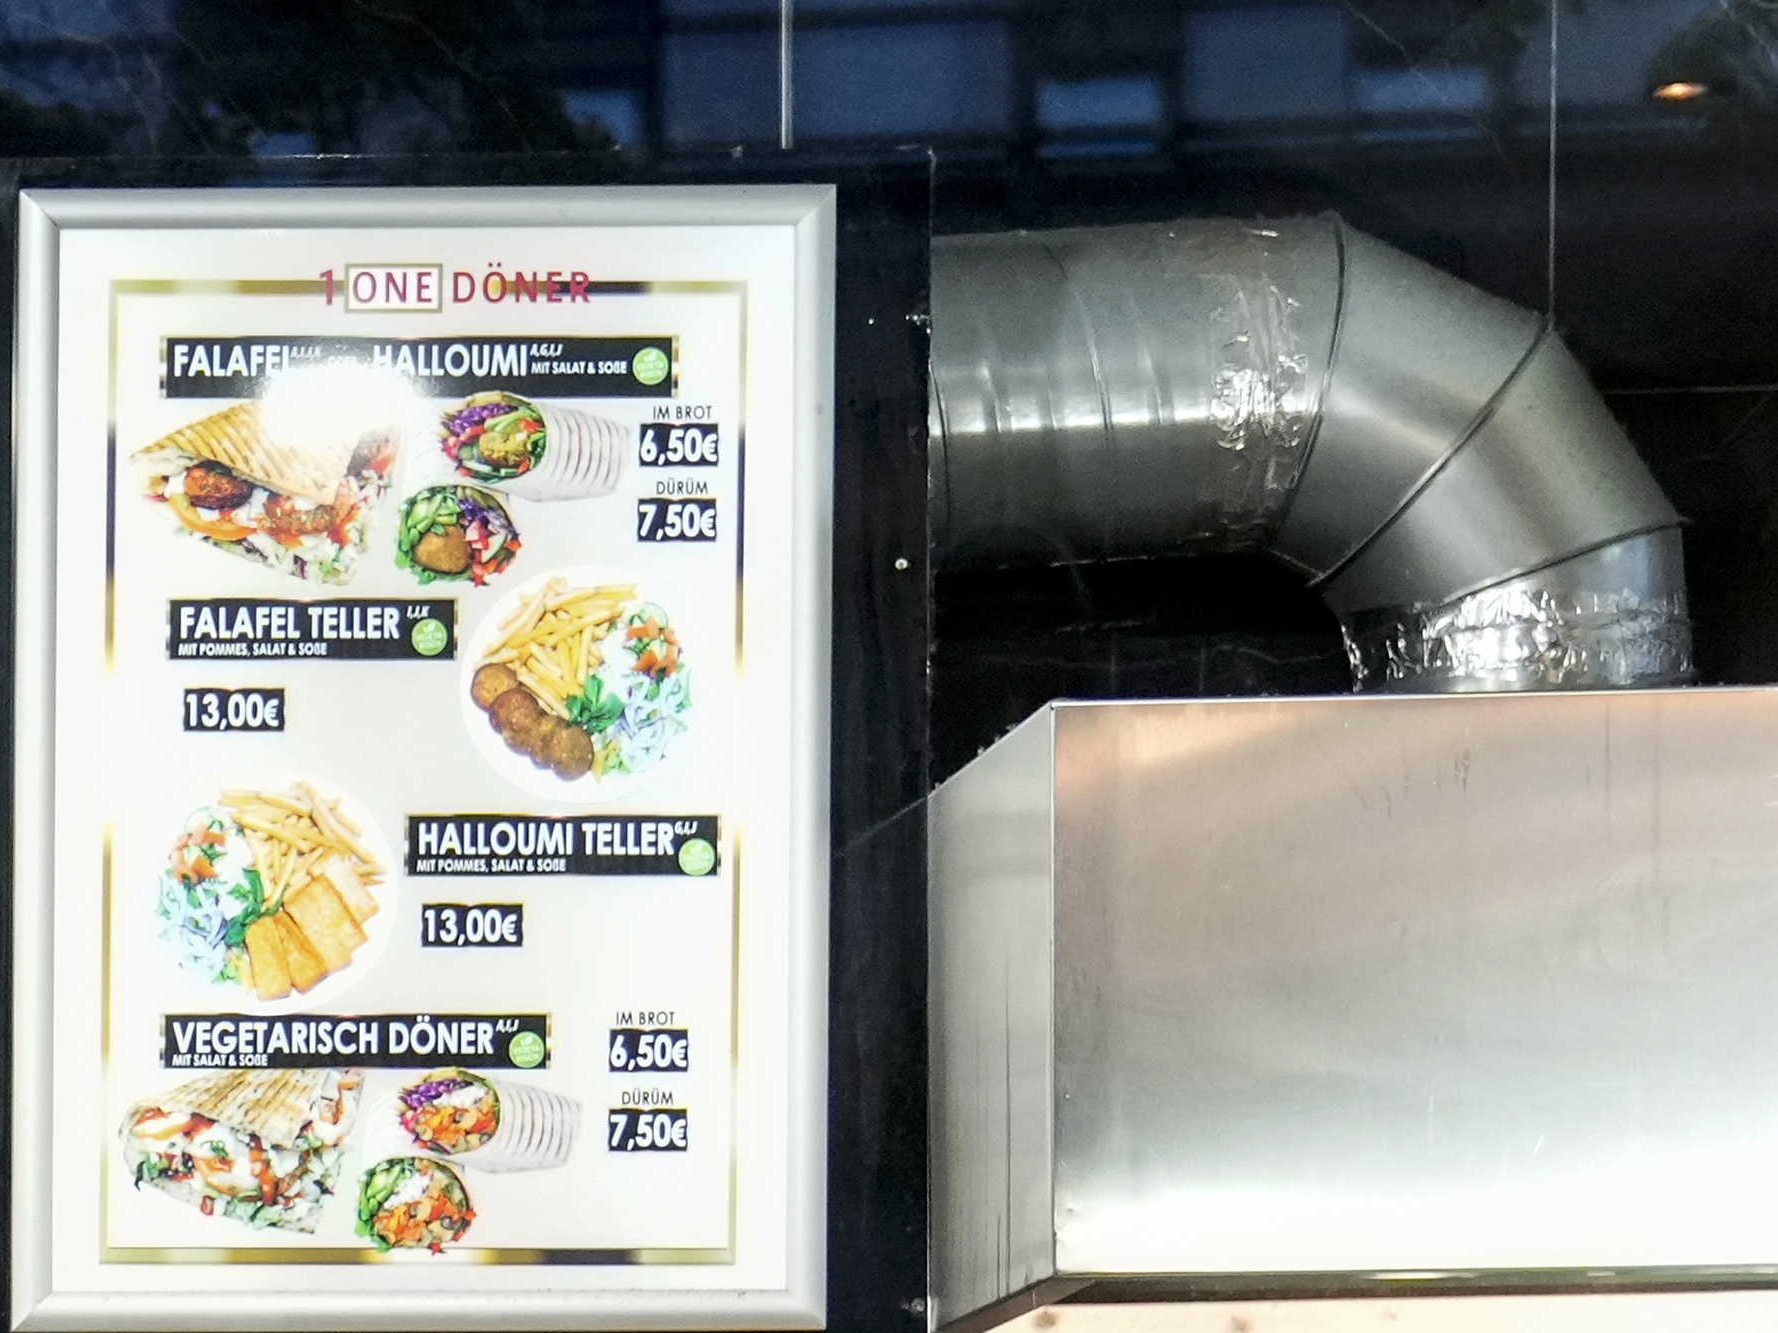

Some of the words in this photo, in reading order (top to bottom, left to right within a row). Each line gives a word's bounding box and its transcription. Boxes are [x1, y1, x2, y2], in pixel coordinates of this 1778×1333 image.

[320, 269, 335, 304] 1
[354, 271, 433, 303] ONE
[454, 264, 591, 304] DÖNER
[531, 363, 551, 375] MIT
[552, 363, 585, 375] SALAT
[653, 406, 670, 420] IM
[676, 405, 712, 420] BROT
[640, 428, 718, 466] 6,50€
[656, 478, 708, 496] DÜRÜM
[638, 503, 716, 541] 7,50€
[180, 606, 301, 639] FALAFEL
[307, 606, 400, 640] TELLER
[253, 643, 286, 656] SALAT
[186, 692, 279, 731] 13,00€
[418, 822, 574, 856] HALLOUMI
[581, 822, 675, 856] TELLER
[491, 860, 525, 872] SALAT
[424, 908, 518, 946] 13,00€
[172, 1020, 379, 1056] VEGETARISCH
[389, 1014, 494, 1055] DÖNER
[610, 1033, 688, 1071] 6,50€
[621, 1089, 674, 1106] DÜRÜM
[609, 1113, 687, 1151] 7,50€
